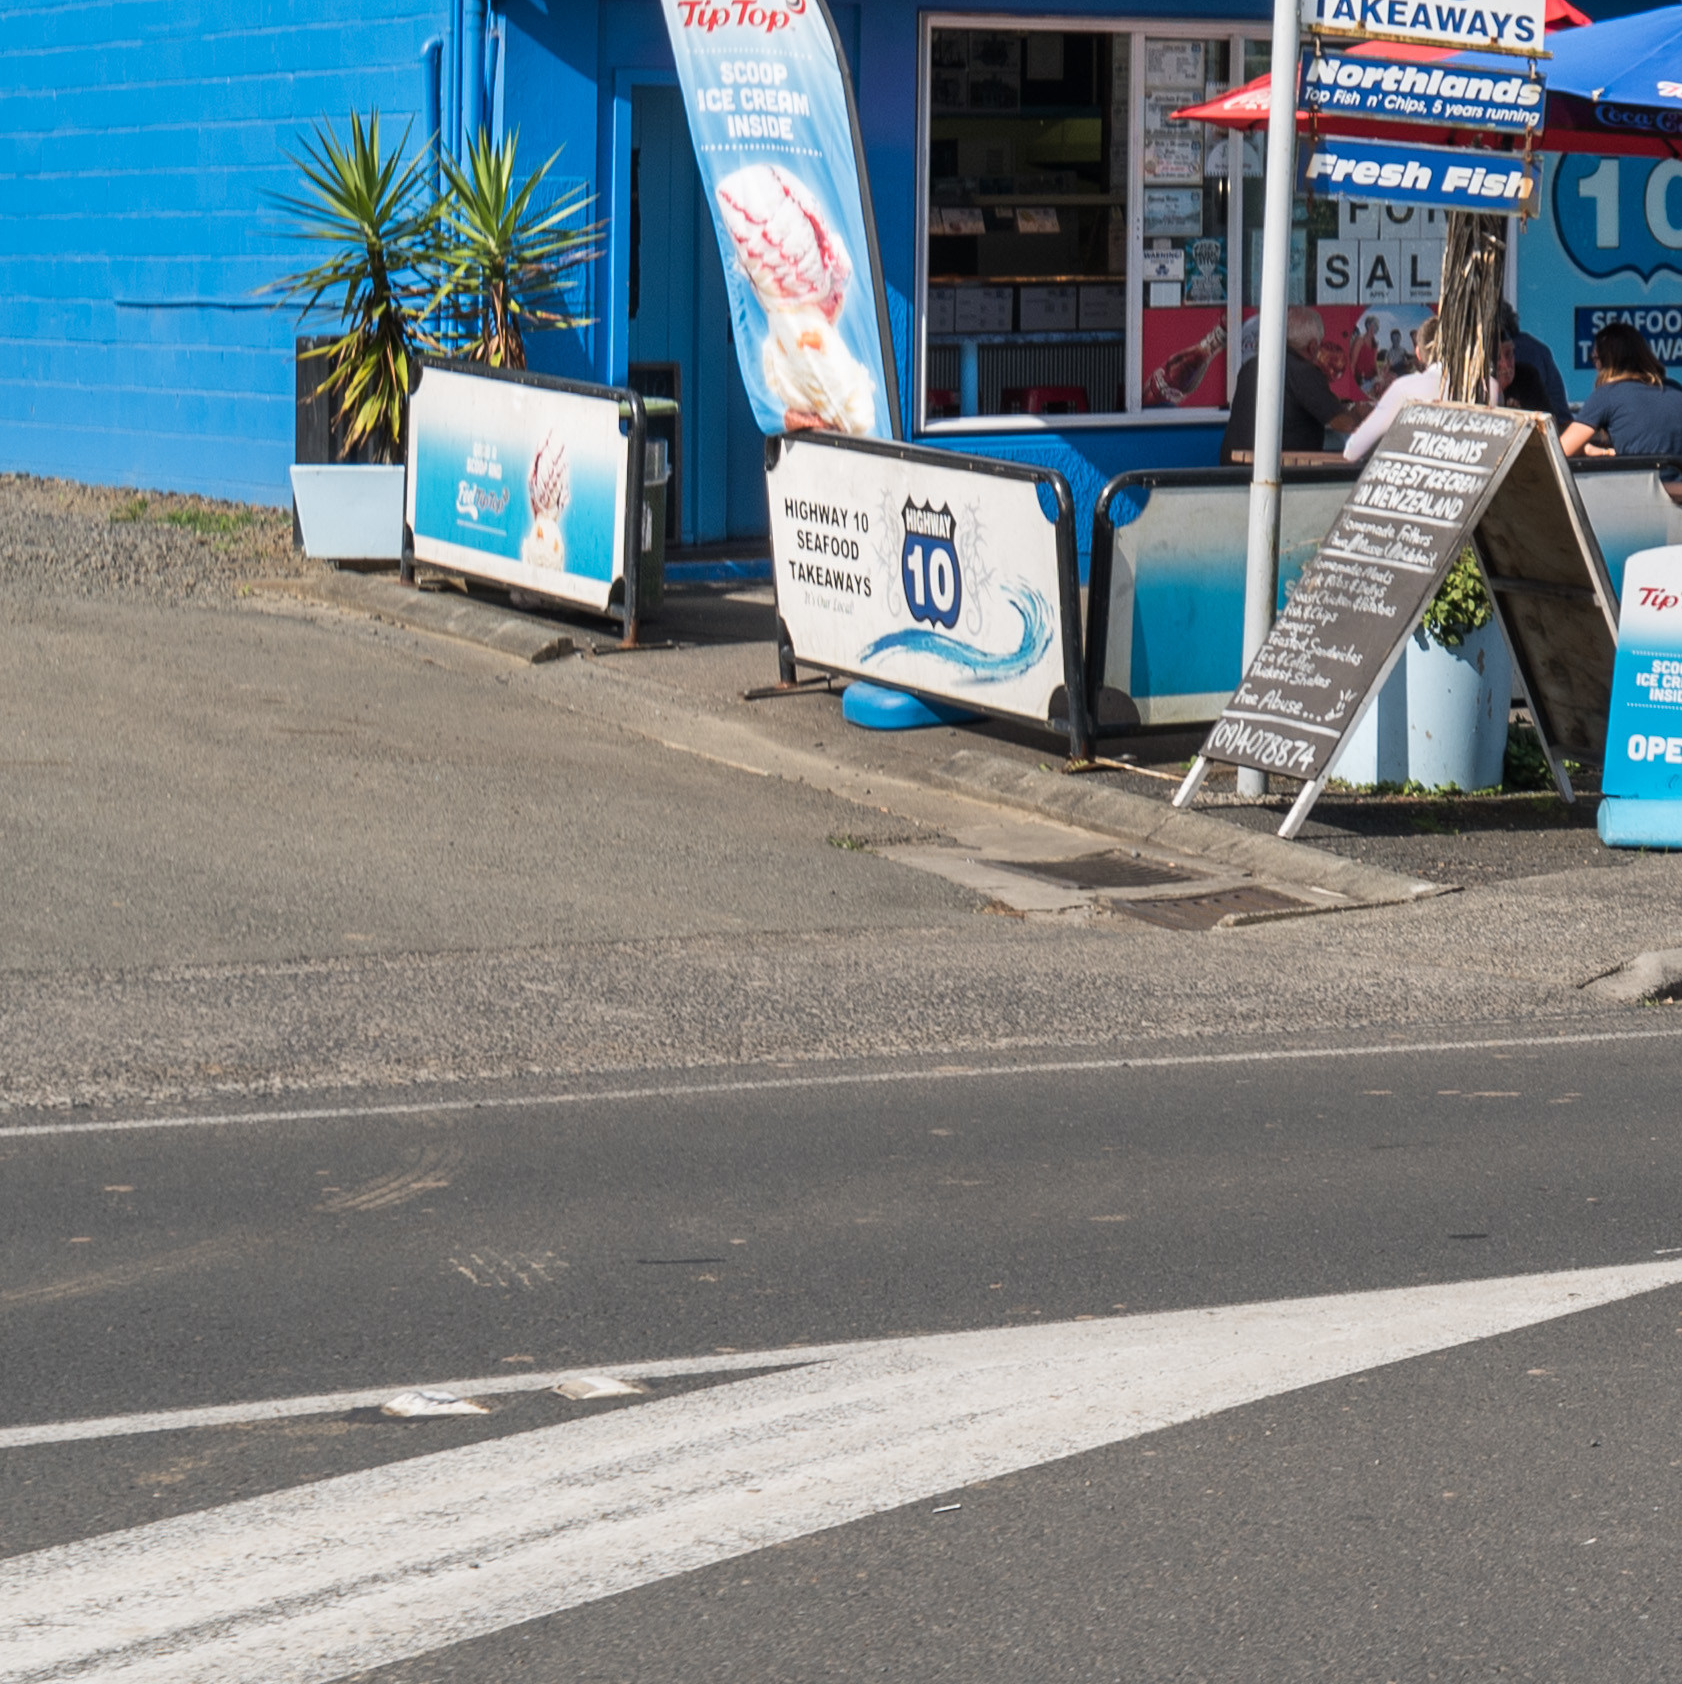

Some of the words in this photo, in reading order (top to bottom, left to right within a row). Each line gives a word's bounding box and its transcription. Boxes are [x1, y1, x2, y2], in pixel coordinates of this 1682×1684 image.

[719, 60, 788, 88] SCOOP
[1305, 57, 1543, 106] Northlands
[698, 87, 736, 112] ICE
[740, 89, 811, 116] CREAM
[1304, 86, 1331, 103] Top
[1332, 90, 1361, 106] Fish
[1366, 93, 1383, 108] n'
[1384, 94, 1428, 115] Chips,
[1431, 99, 1442, 114] 5
[1444, 103, 1484, 120] years
[1485, 105, 1541, 128] running
[727, 114, 794, 140] INSIDE
[1305, 152, 1437, 191] Fresh
[1441, 165, 1534, 200] Fish
[1325, 253, 1433, 290] SAL
[1408, 430, 1488, 464] TAKEAWAYS
[784, 497, 848, 528] HIGHWAY
[853, 510, 869, 534] 10
[905, 507, 952, 540] HIGHWAY
[796, 529, 860, 562] SEAFOOD
[788, 559, 872, 598] TAKEAWAYS
[907, 543, 955, 613] 10
[1638, 586, 1680, 614] Tip
[1233, 682, 1260, 706] Free
[1636, 673, 1661, 689] ICE
